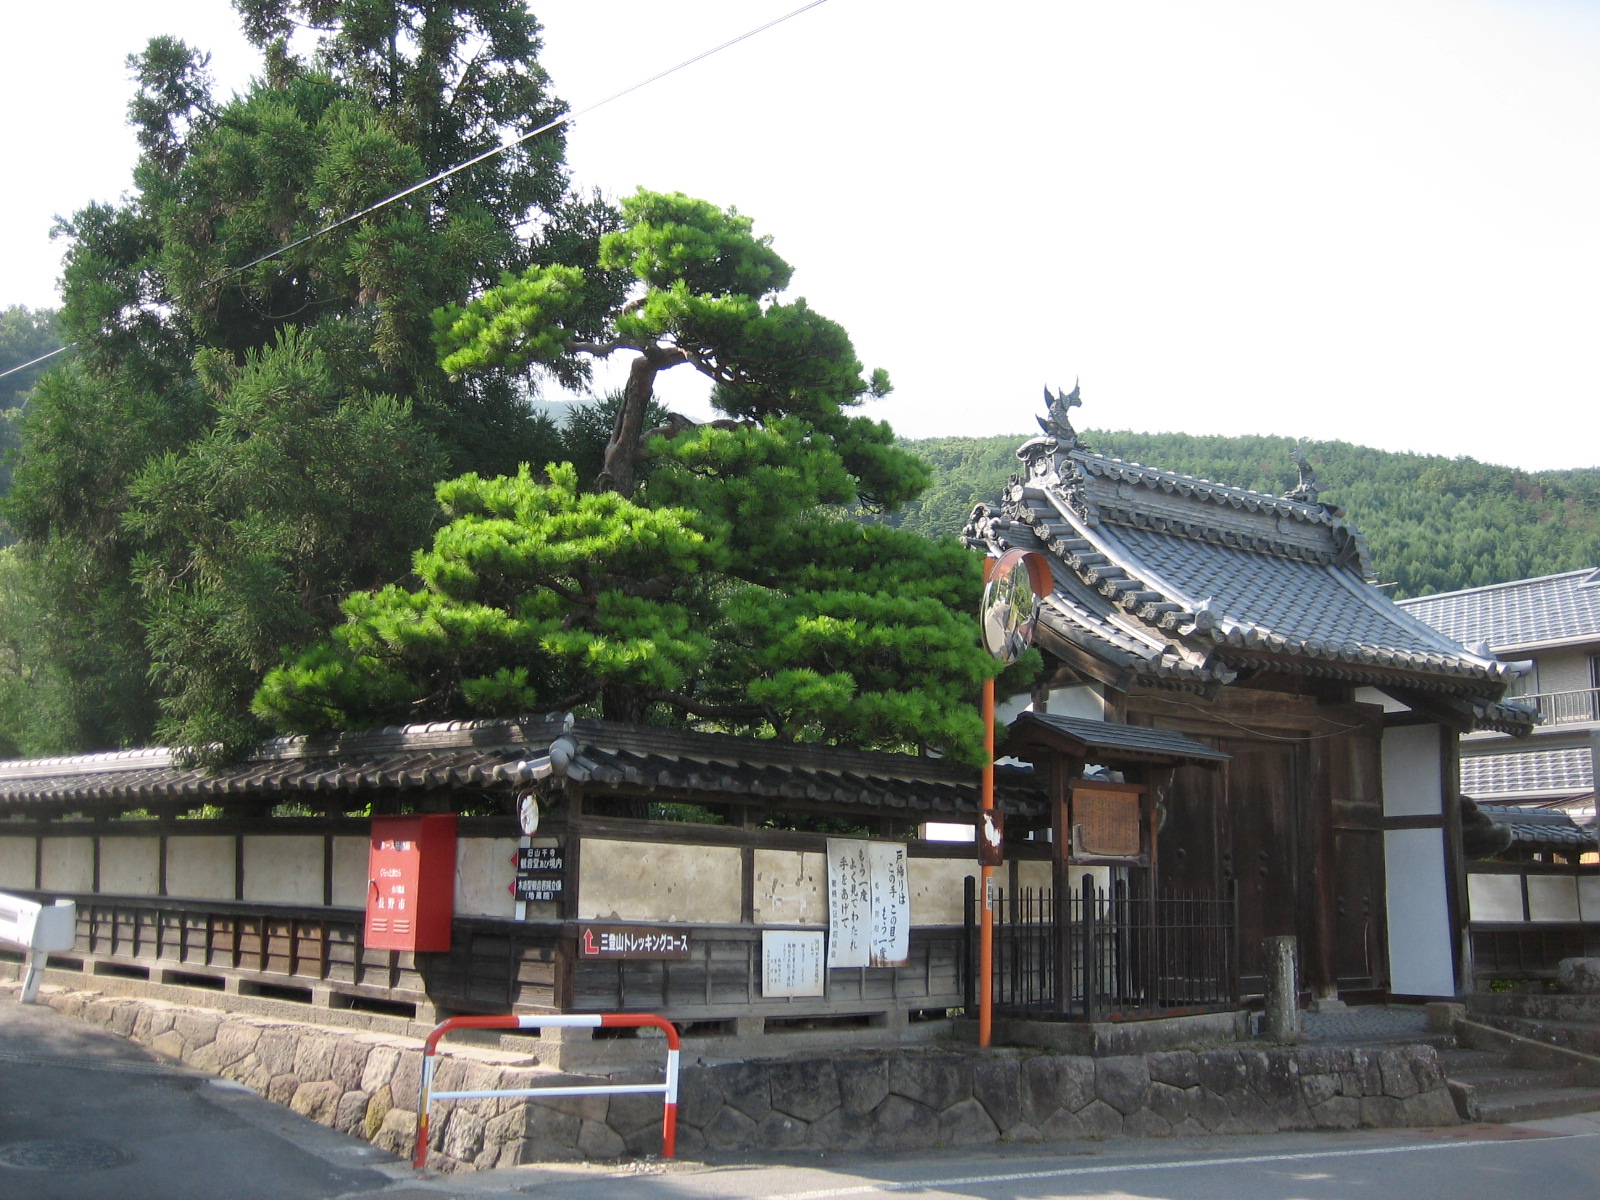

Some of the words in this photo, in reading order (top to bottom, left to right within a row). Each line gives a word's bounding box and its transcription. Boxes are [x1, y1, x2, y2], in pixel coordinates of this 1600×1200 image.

[527, 849, 556, 857] 旧山千寺
[858, 848, 869, 903] もう一度
[895, 849, 906, 906] 戸締りは
[378, 897, 406, 911] 長野市
[839, 856, 850, 929] 手をあげて
[849, 857, 860, 952] よく見てわたれ
[600, 933, 688, 952] 三登山トレッキングコース
[878, 906, 888, 961] もう一度
